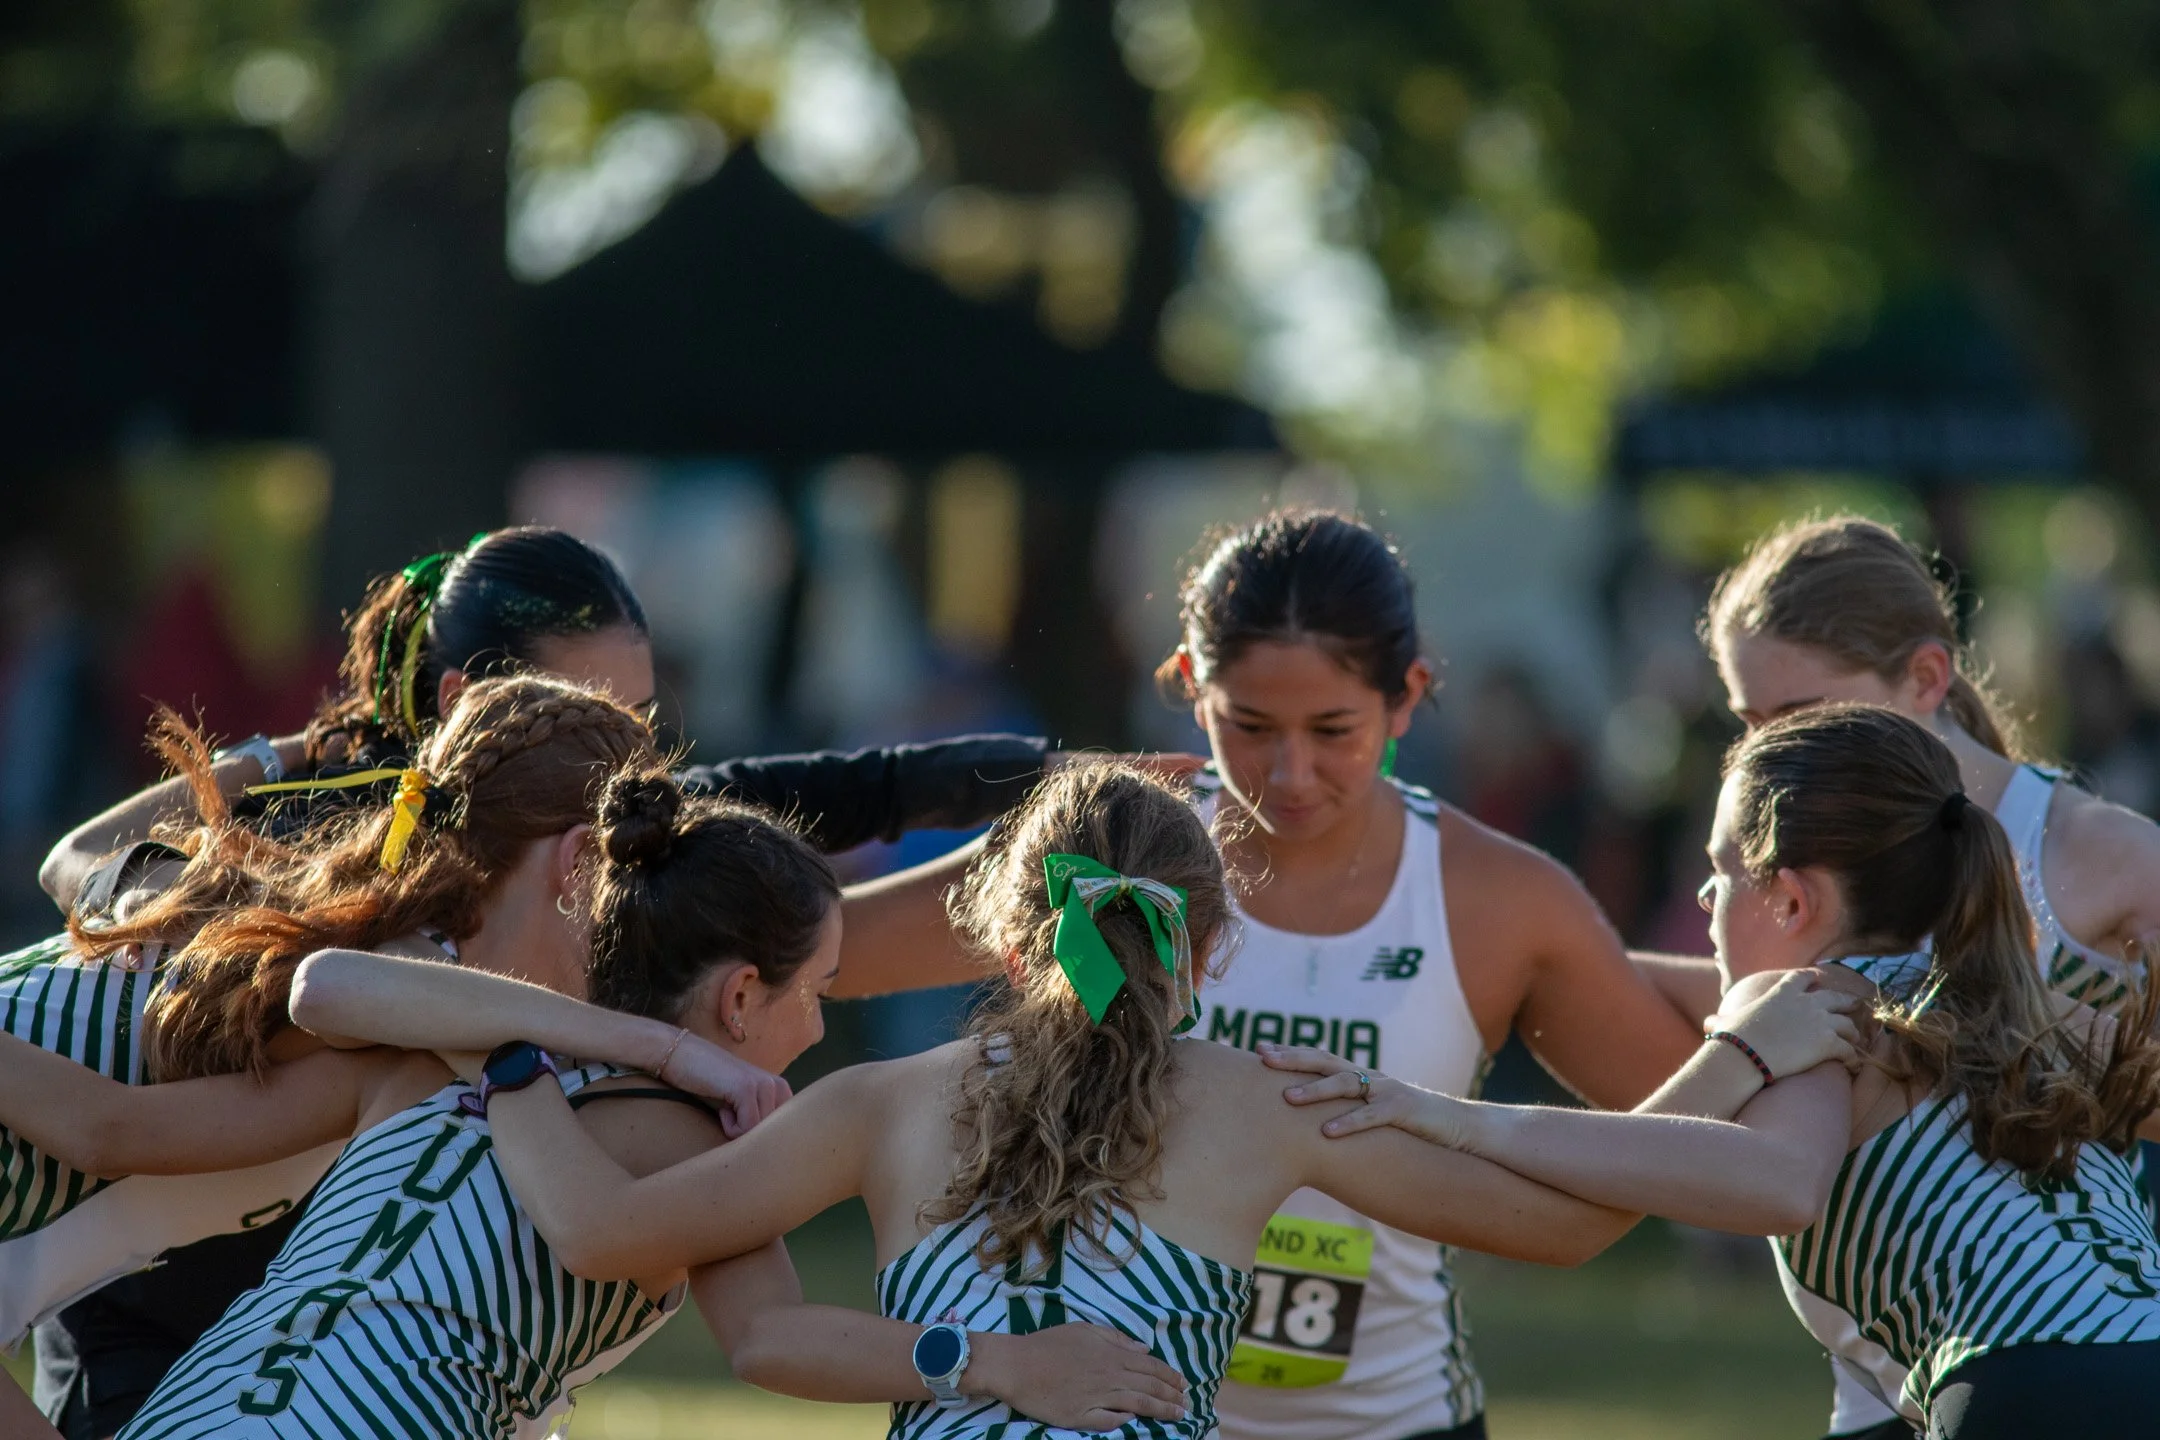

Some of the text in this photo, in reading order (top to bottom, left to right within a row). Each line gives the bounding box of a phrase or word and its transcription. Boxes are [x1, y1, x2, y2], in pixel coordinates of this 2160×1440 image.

[237, 1108, 493, 1417] UMAS
[1260, 1226, 1349, 1262] ND XC
